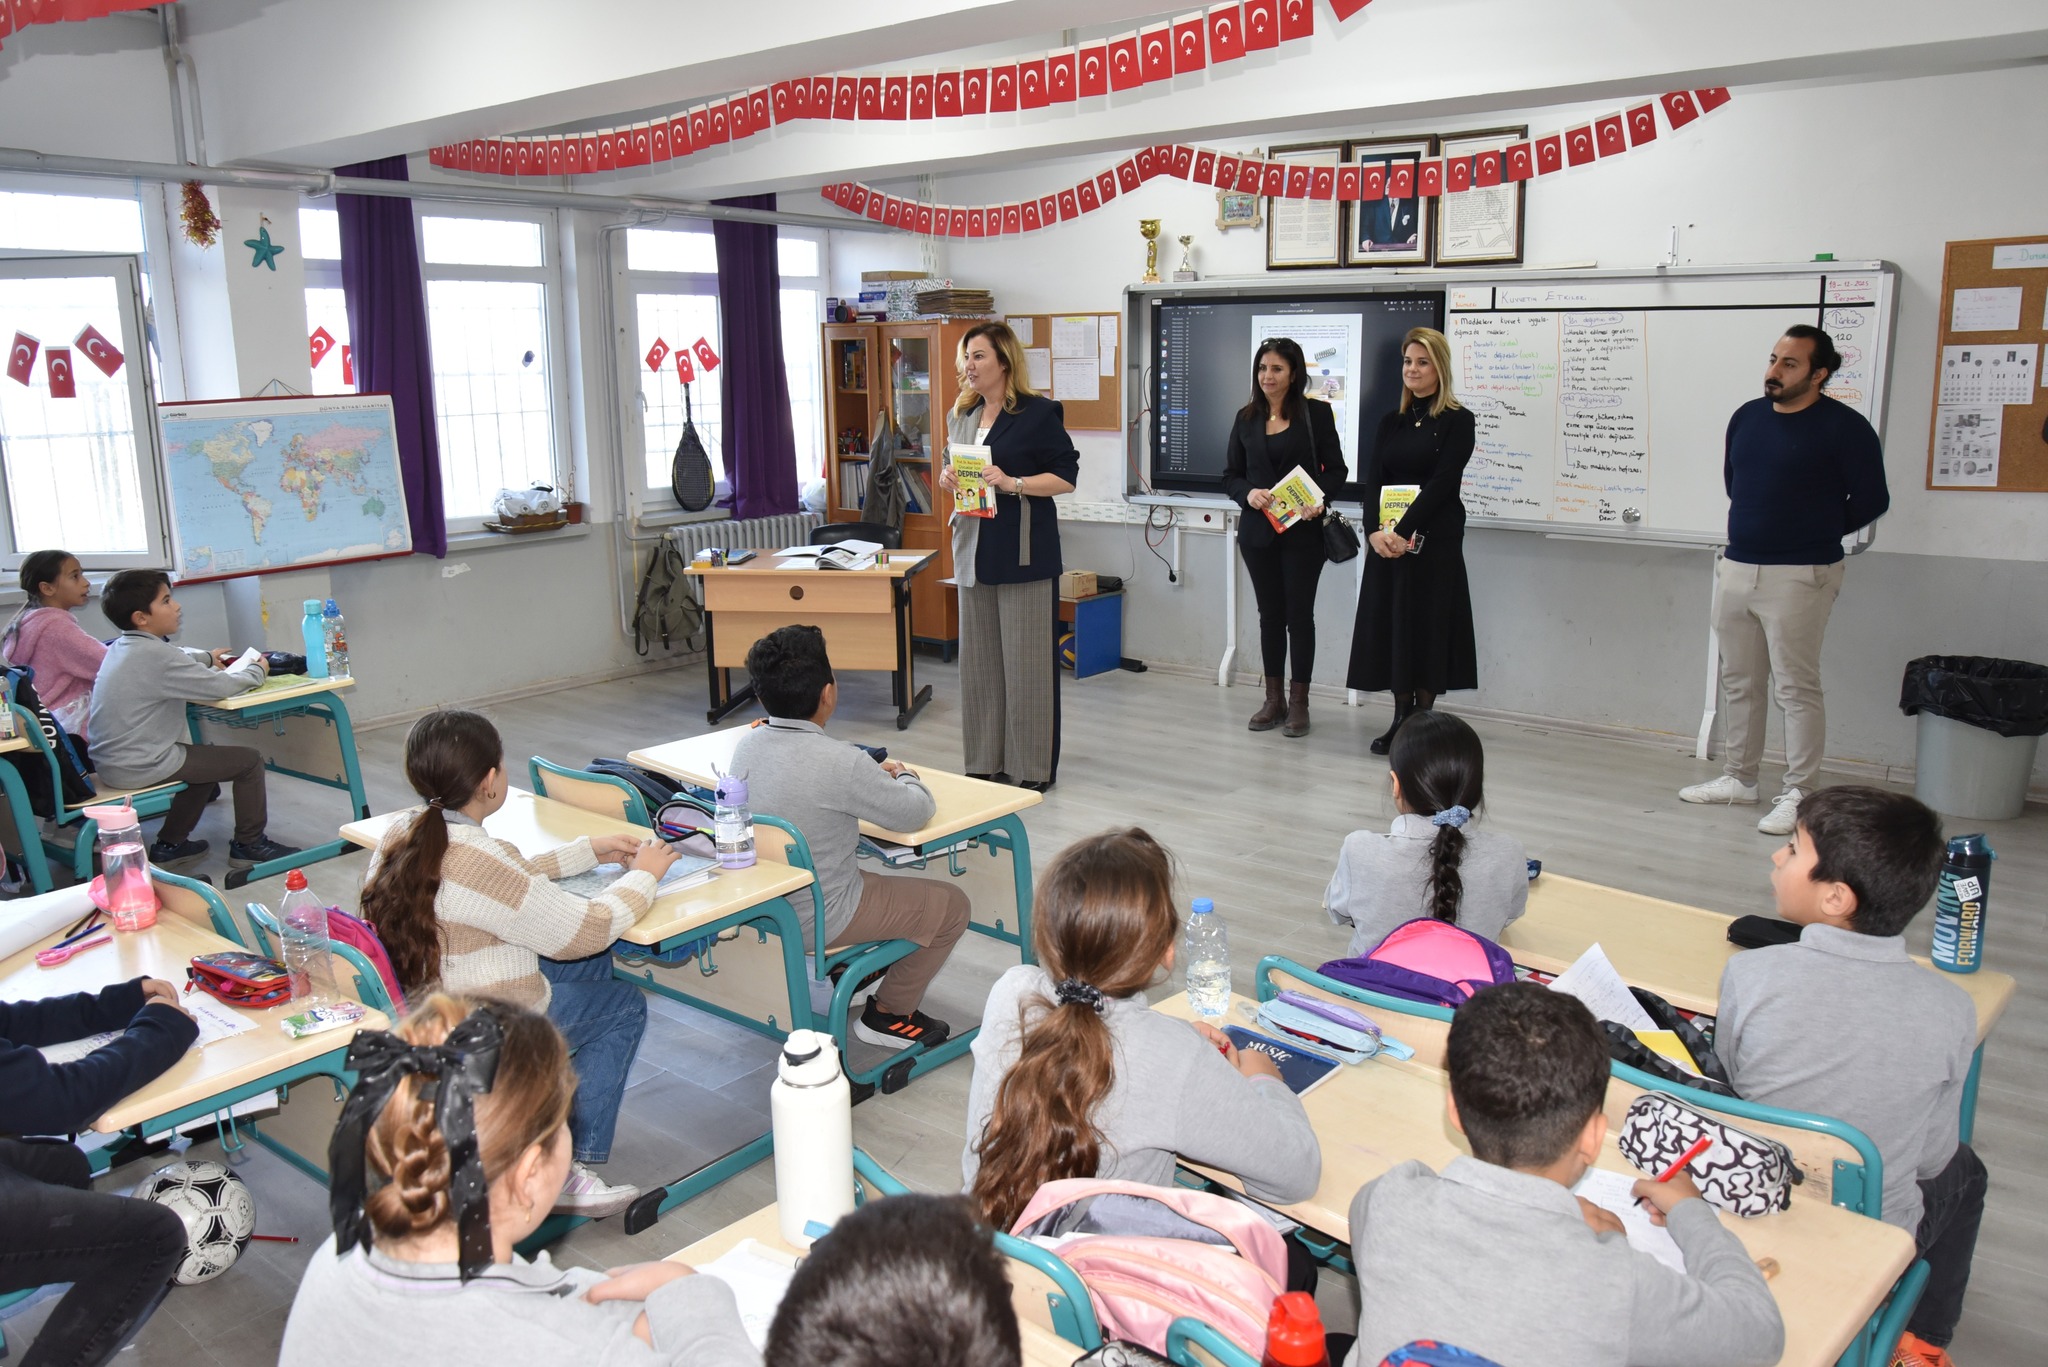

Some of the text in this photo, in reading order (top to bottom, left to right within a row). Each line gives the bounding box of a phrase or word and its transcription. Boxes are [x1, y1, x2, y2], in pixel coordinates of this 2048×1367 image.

[1834, 333, 1853, 341] 120
[1967, 880, 1980, 896] UP
[1932, 870, 1962, 964] MOVING
[1956, 901, 1980, 966] FORWARD
[1246, 1040, 1293, 1062] MUSIC
